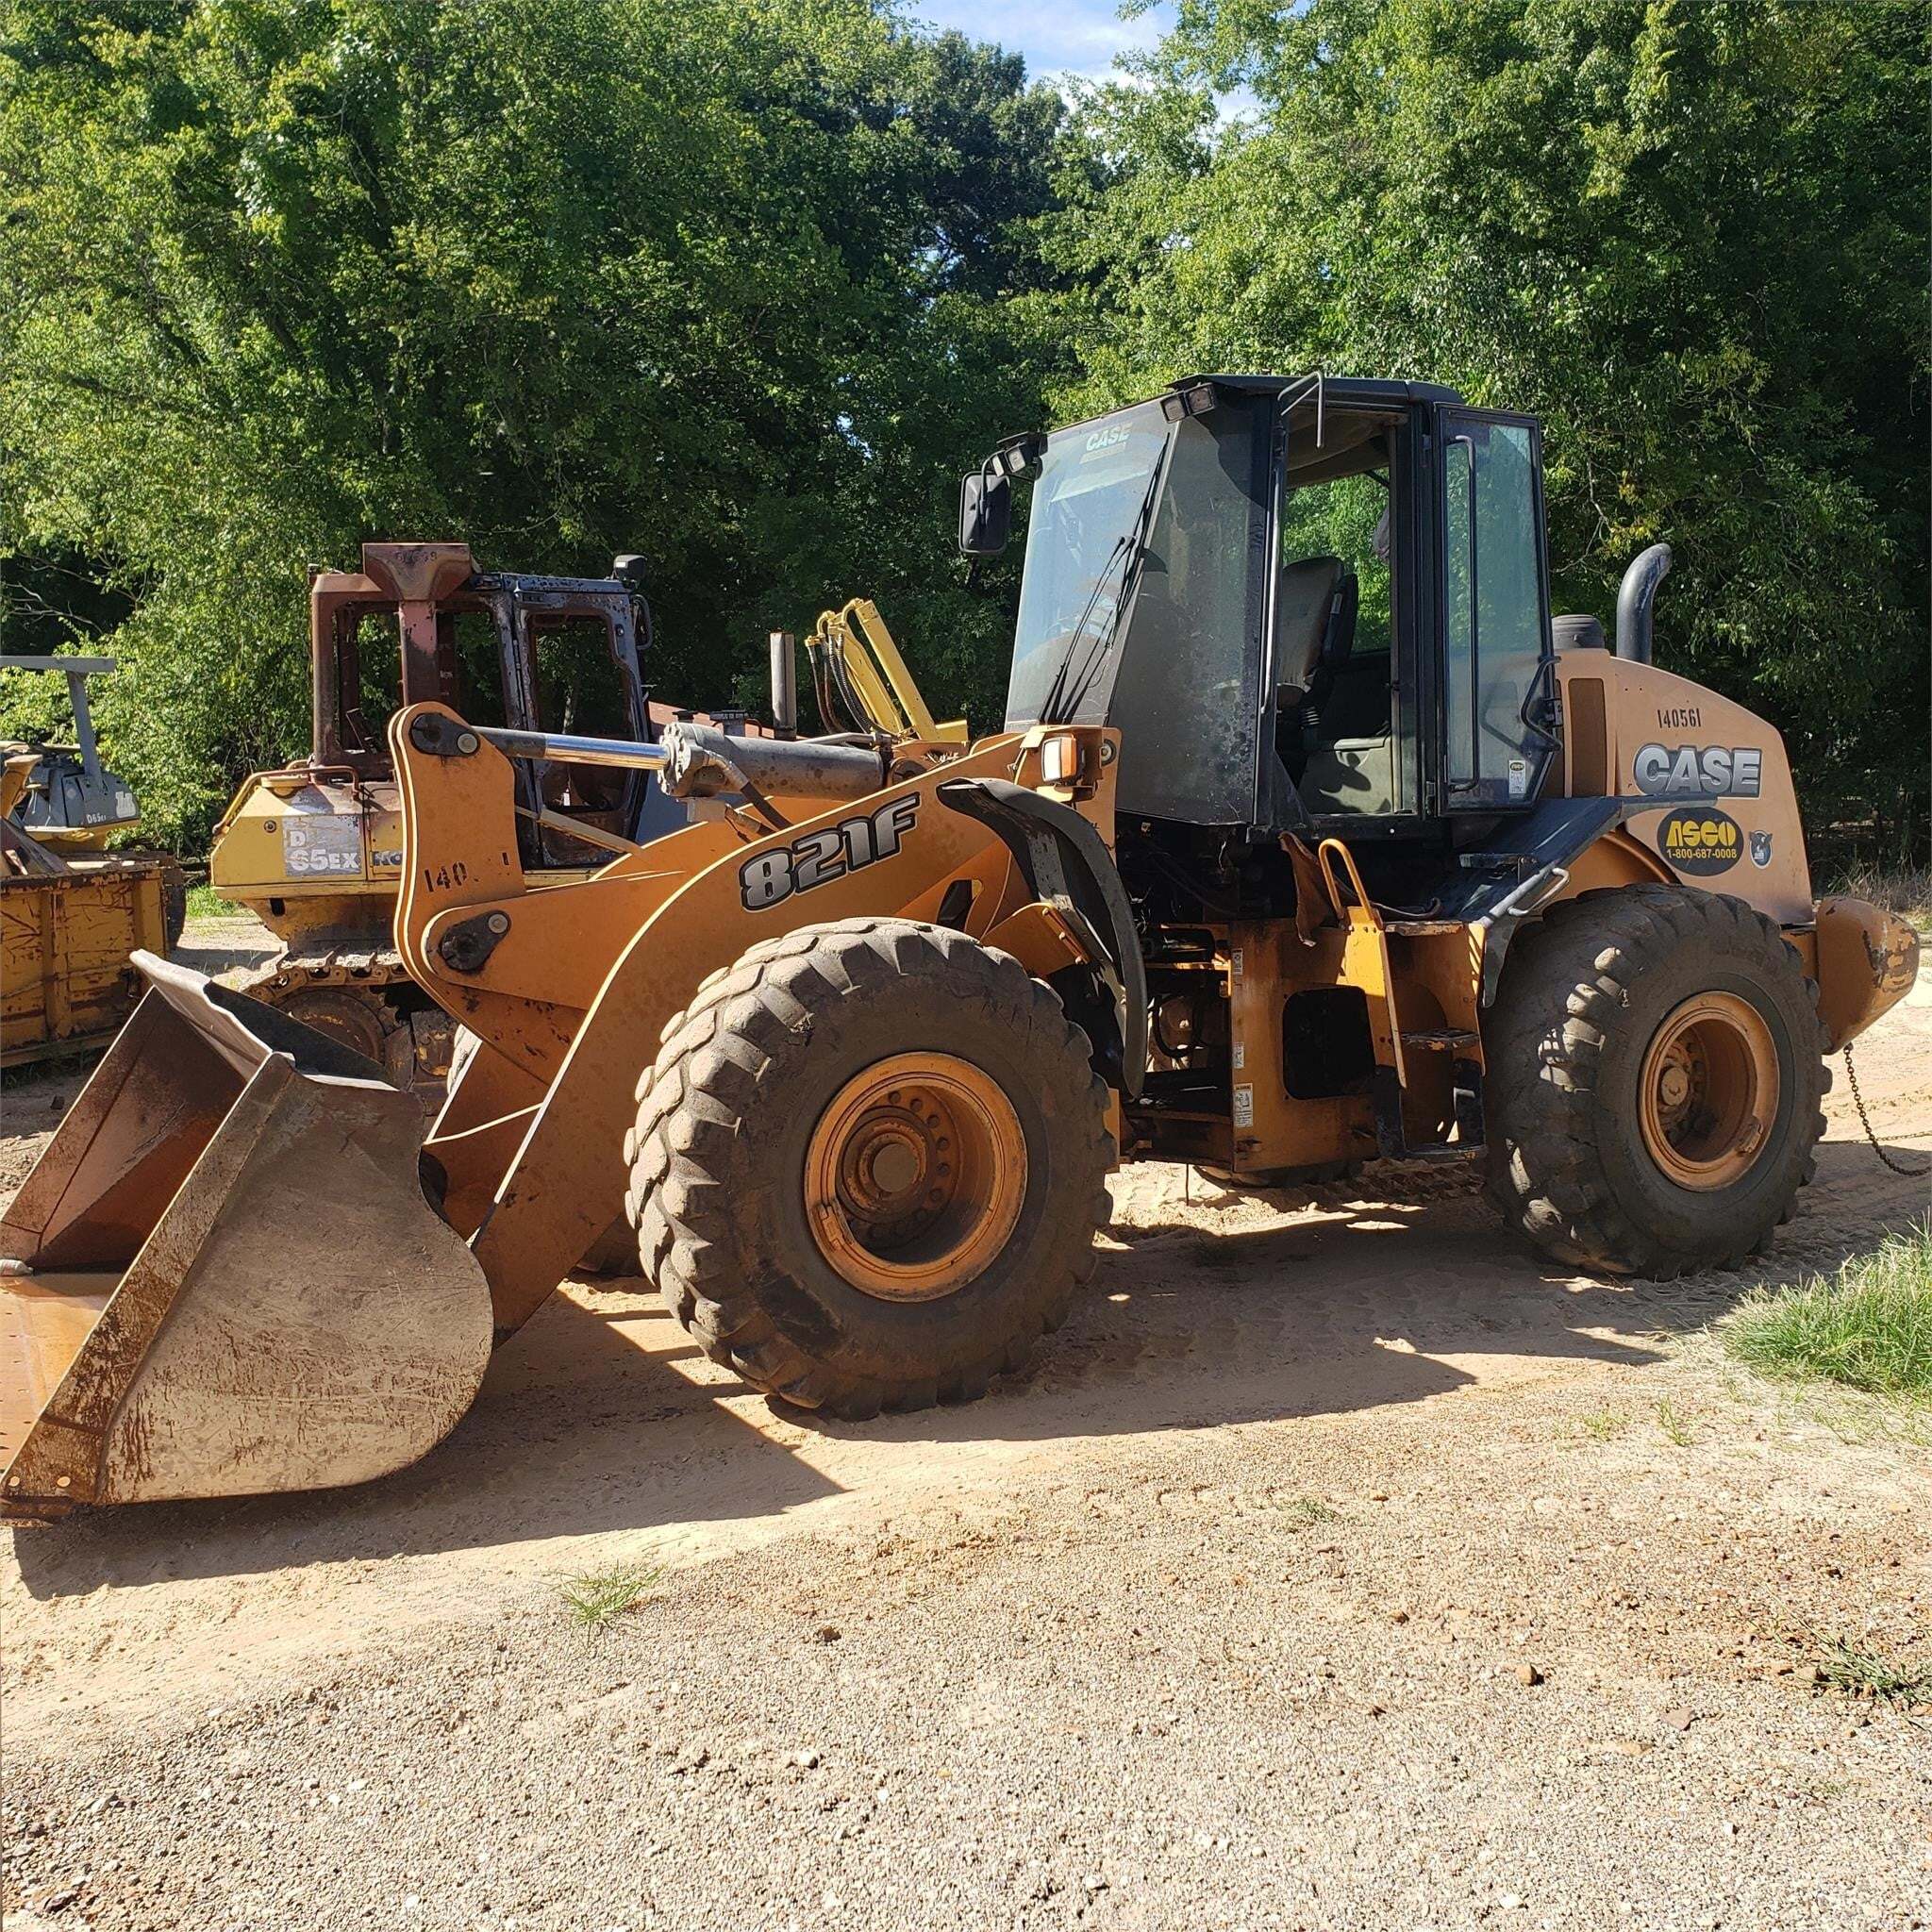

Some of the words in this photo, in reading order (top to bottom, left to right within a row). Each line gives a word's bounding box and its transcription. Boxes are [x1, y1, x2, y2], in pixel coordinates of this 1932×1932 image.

[1086, 423, 1132, 452] CASE
[1657, 708, 1702, 728] 140561
[1633, 743, 1761, 796] CASE
[739, 791, 921, 912] 821F
[1667, 848, 1738, 859] 1-800-687-0008
[425, 852, 510, 892] 1401
